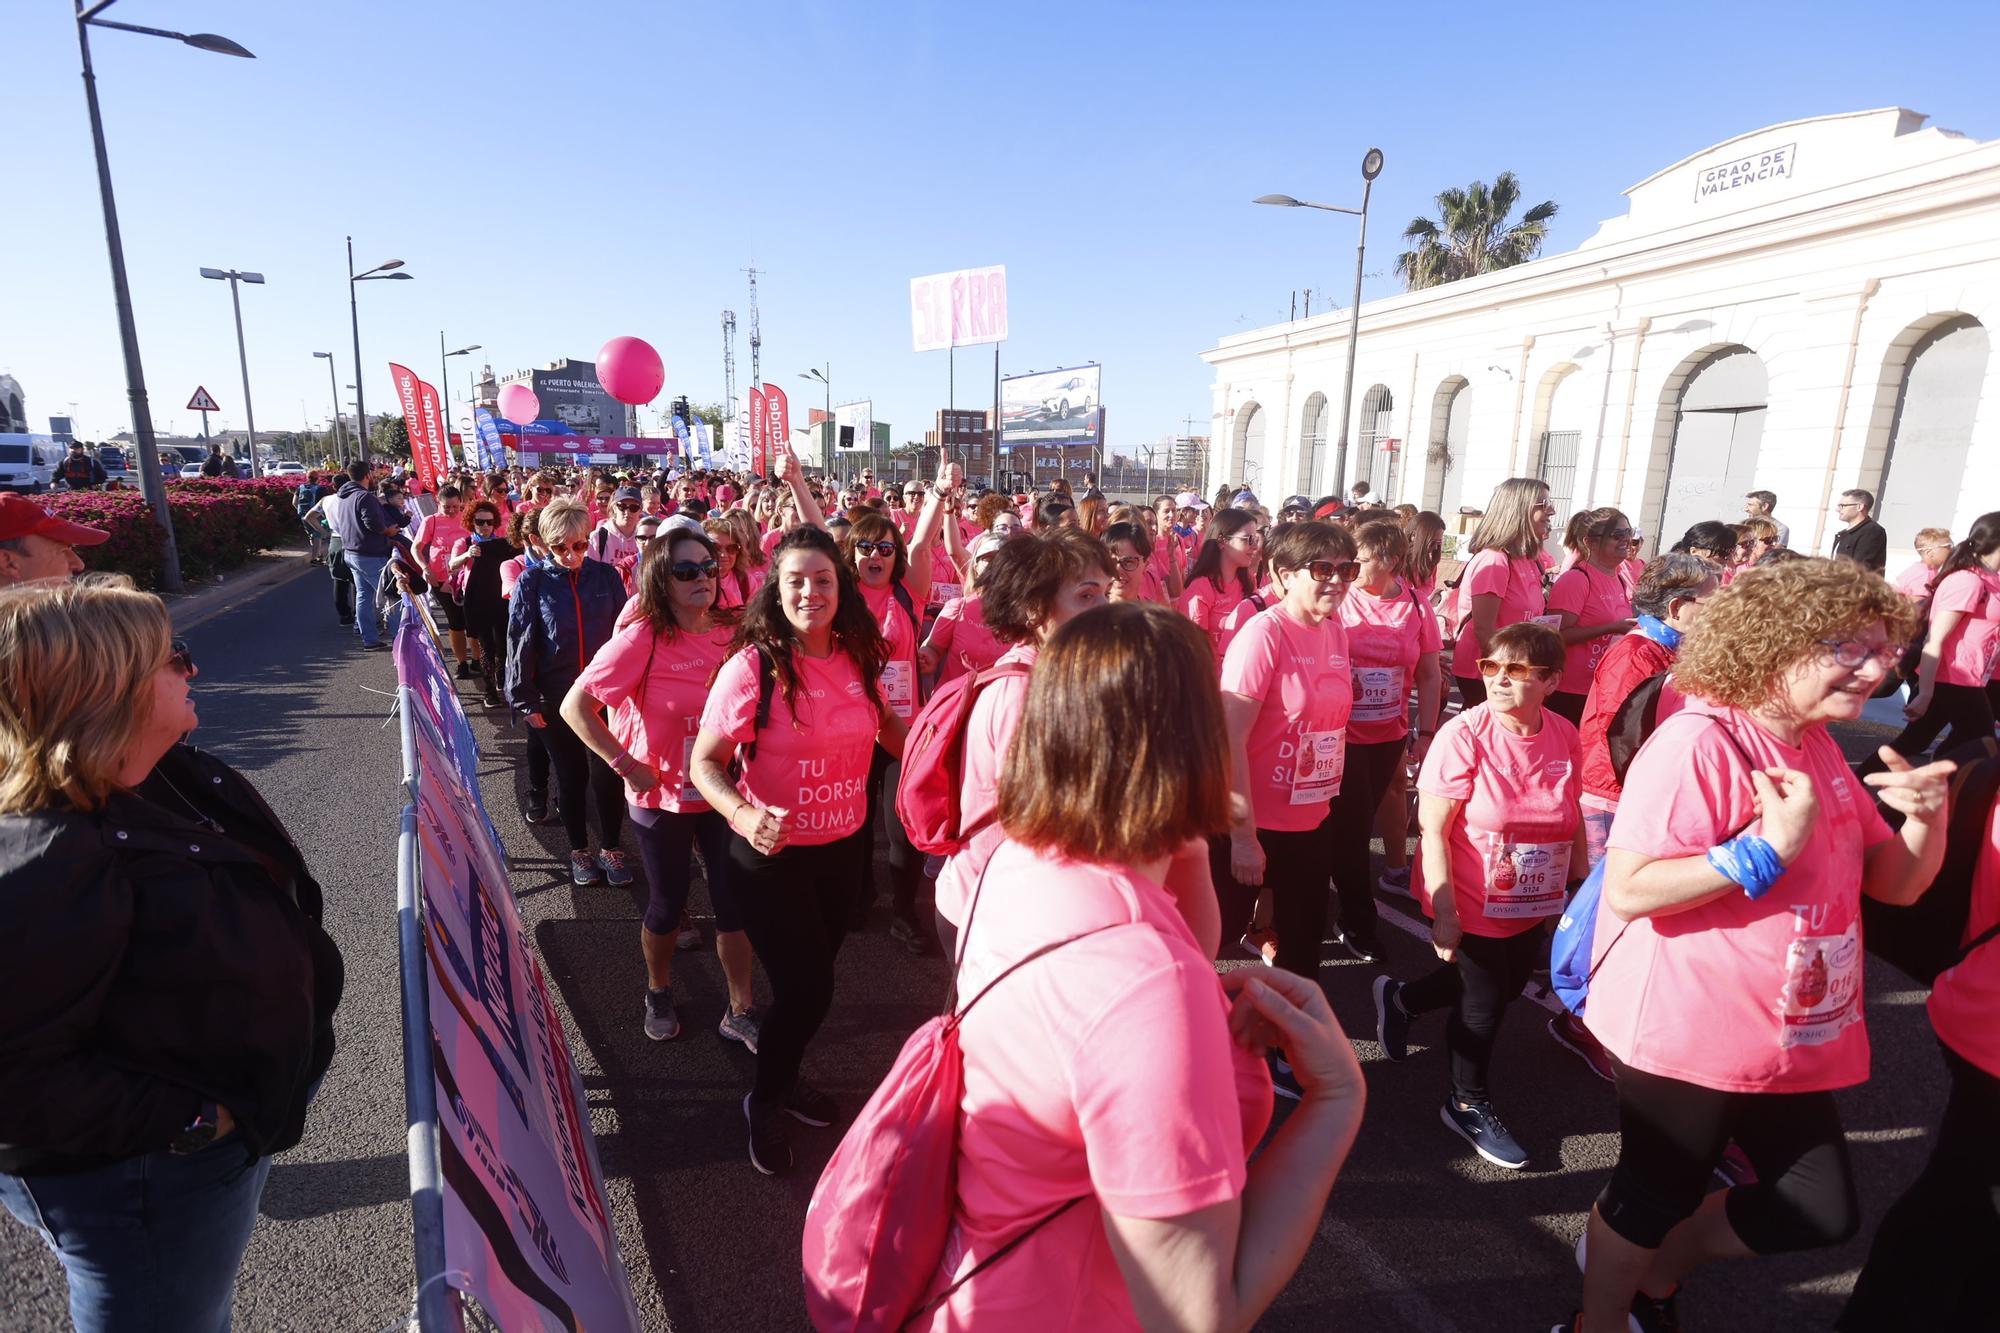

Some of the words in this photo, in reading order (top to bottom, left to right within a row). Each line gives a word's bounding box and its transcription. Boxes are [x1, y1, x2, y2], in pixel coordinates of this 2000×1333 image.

[1706, 161, 1751, 183] GRAO
[1760, 150, 1786, 168] DE
[1701, 164, 1786, 197] VALENCIA
[671, 658, 704, 672] OYSHO
[1365, 688, 1387, 697] 016
[798, 758, 825, 778] TU
[1316, 758, 1334, 770] 016
[795, 805, 855, 830] SUMA
[1519, 872, 1545, 884] 016
[1790, 903, 1829, 932] TU
